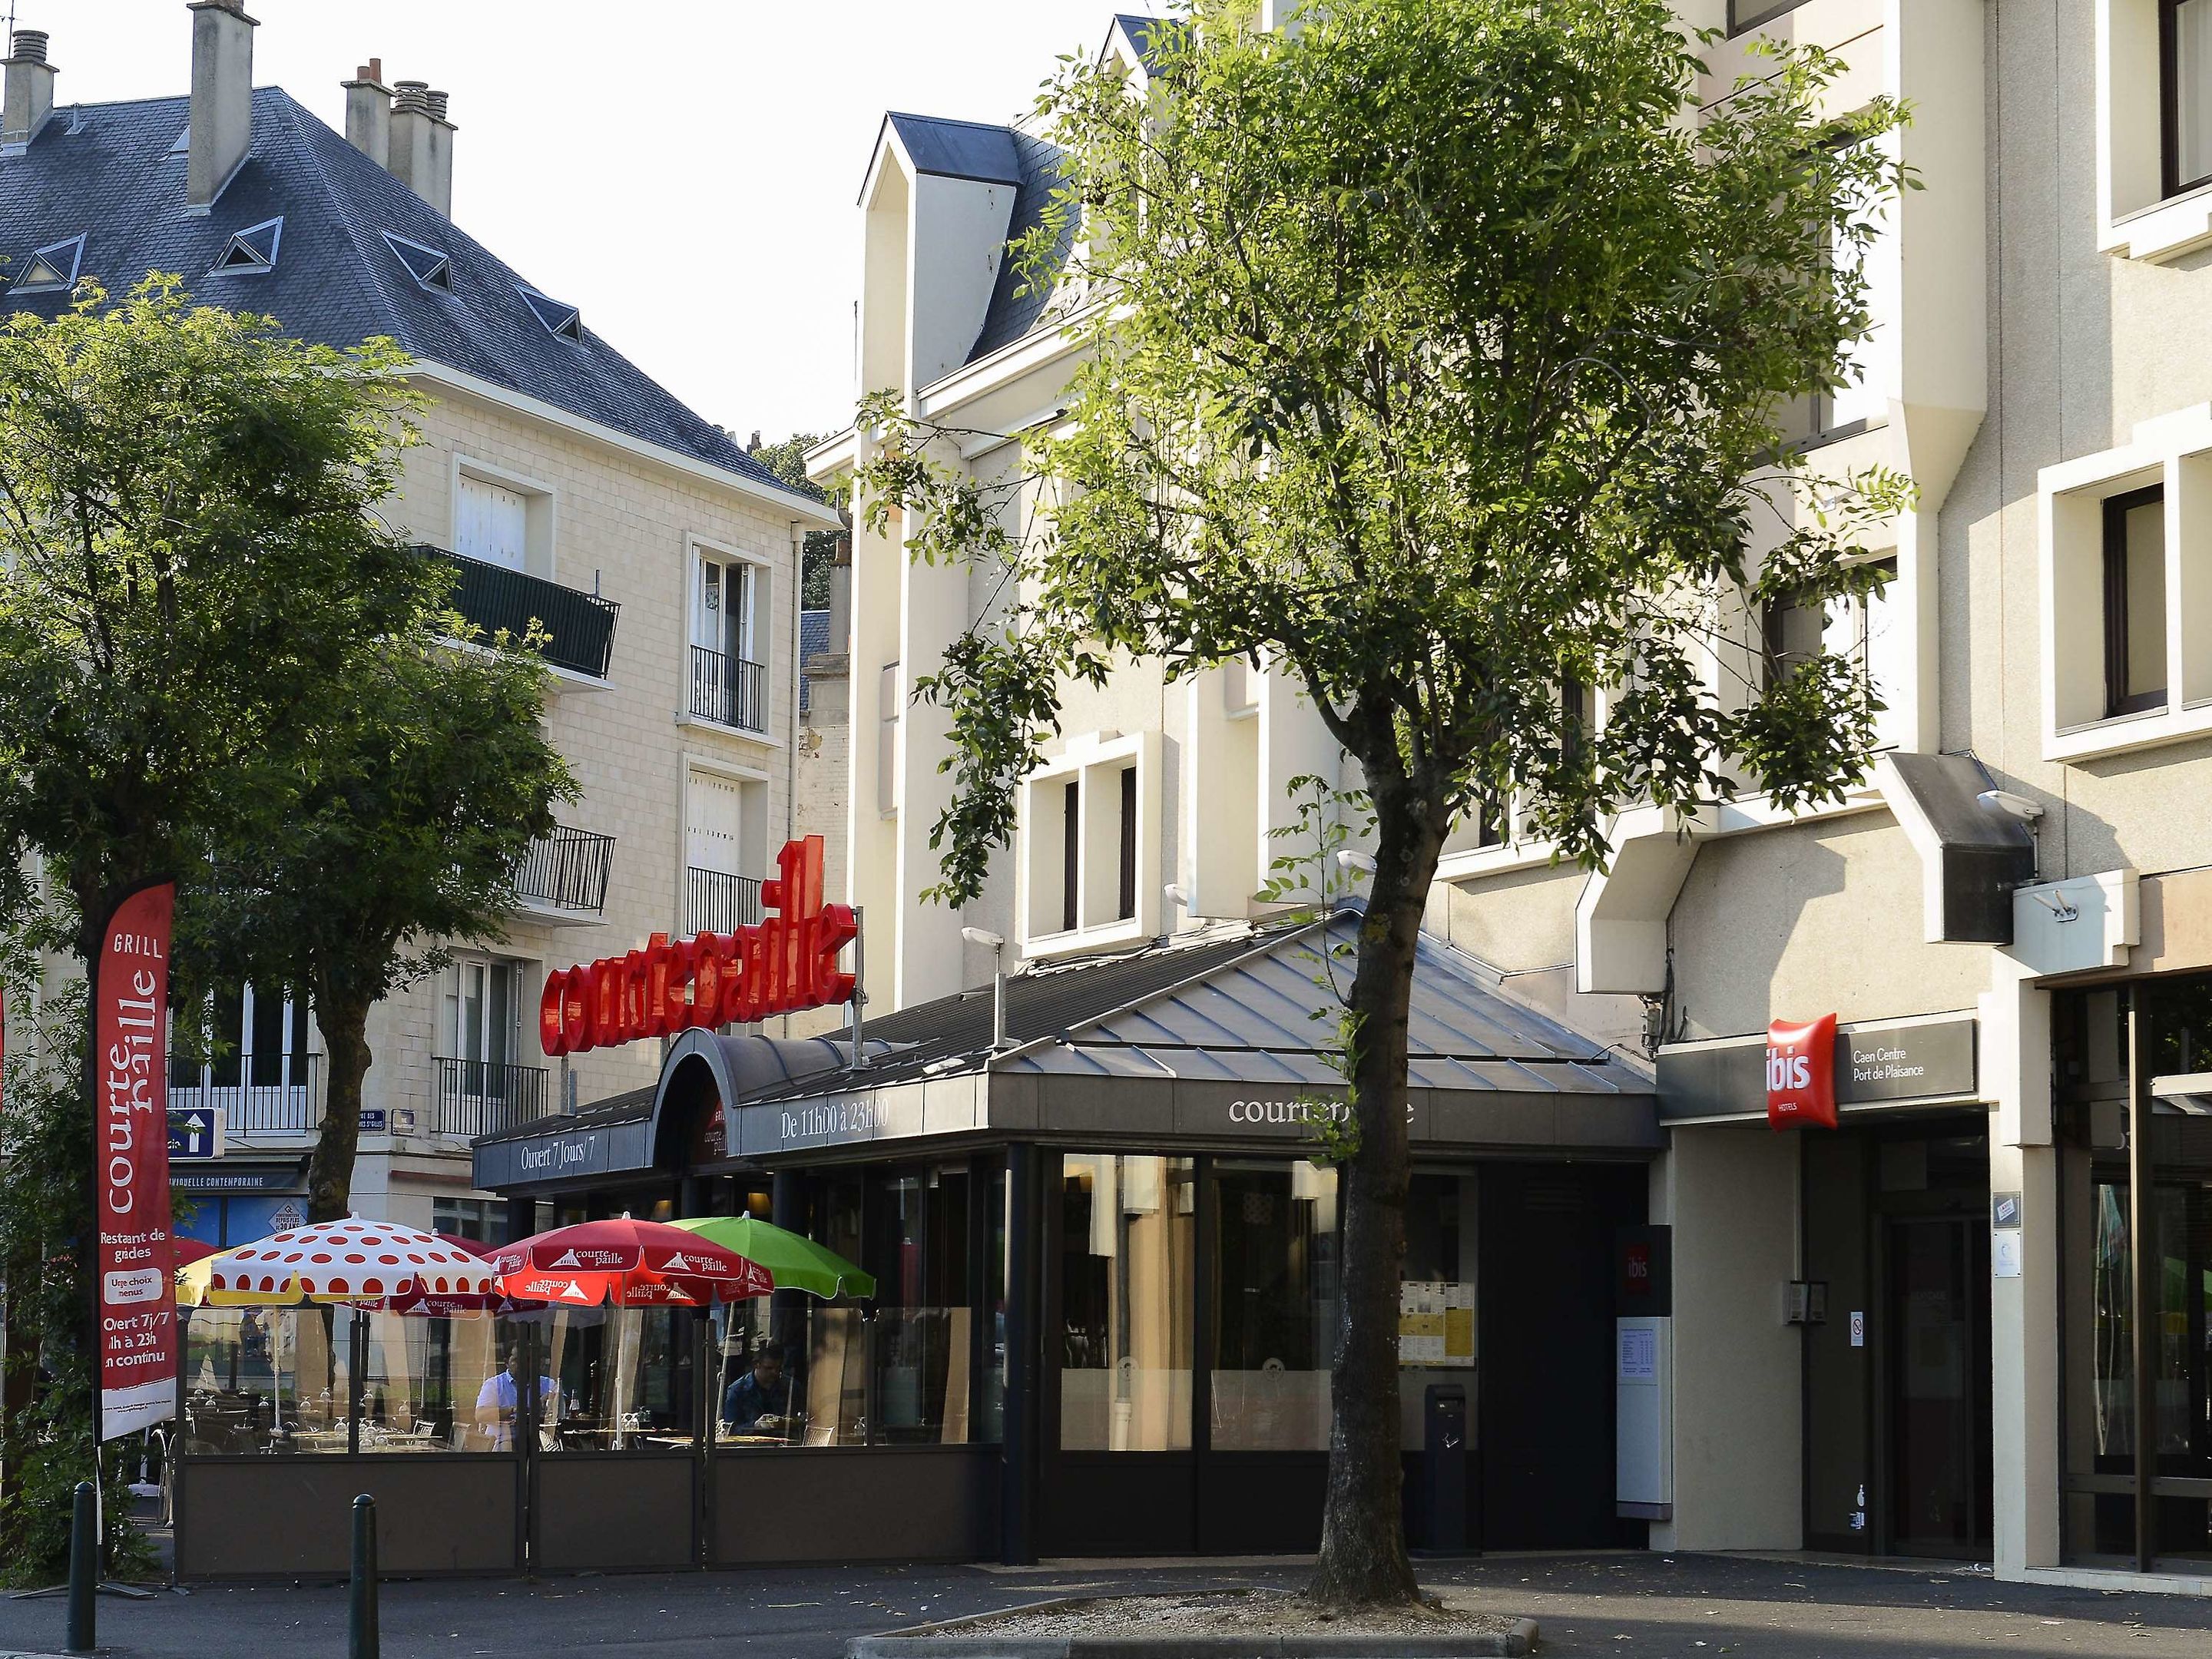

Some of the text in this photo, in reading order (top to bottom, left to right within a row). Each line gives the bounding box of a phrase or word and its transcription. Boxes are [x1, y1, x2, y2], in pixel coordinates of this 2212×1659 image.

[114, 933, 163, 959] GRILL
[1853, 1047, 1906, 1065] Caen Centre
[1766, 1045, 1811, 1091] ibis
[1853, 1064, 1924, 1081] Port de Plaisance
[780, 1098, 889, 1138] De 11h00 à 23h00
[107, 1043, 134, 1214] courte
[522, 1147, 551, 1170] Ouvert
[553, 1141, 559, 1166] 7
[206, 1177, 263, 1187] CONTEMPORAINE
[150, 1228, 165, 1241] de
[576, 1250, 609, 1259] courte
[595, 1253, 623, 1267] paille
[684, 1254, 713, 1264] courte
[702, 1260, 727, 1273] paille
[1628, 1257, 1647, 1277] ibis
[129, 1276, 152, 1286] choix
[141, 1311, 170, 1330] 7j/7
[124, 1336, 134, 1348] à
[137, 1331, 157, 1346] 23h
[116, 1350, 165, 1367] continu
